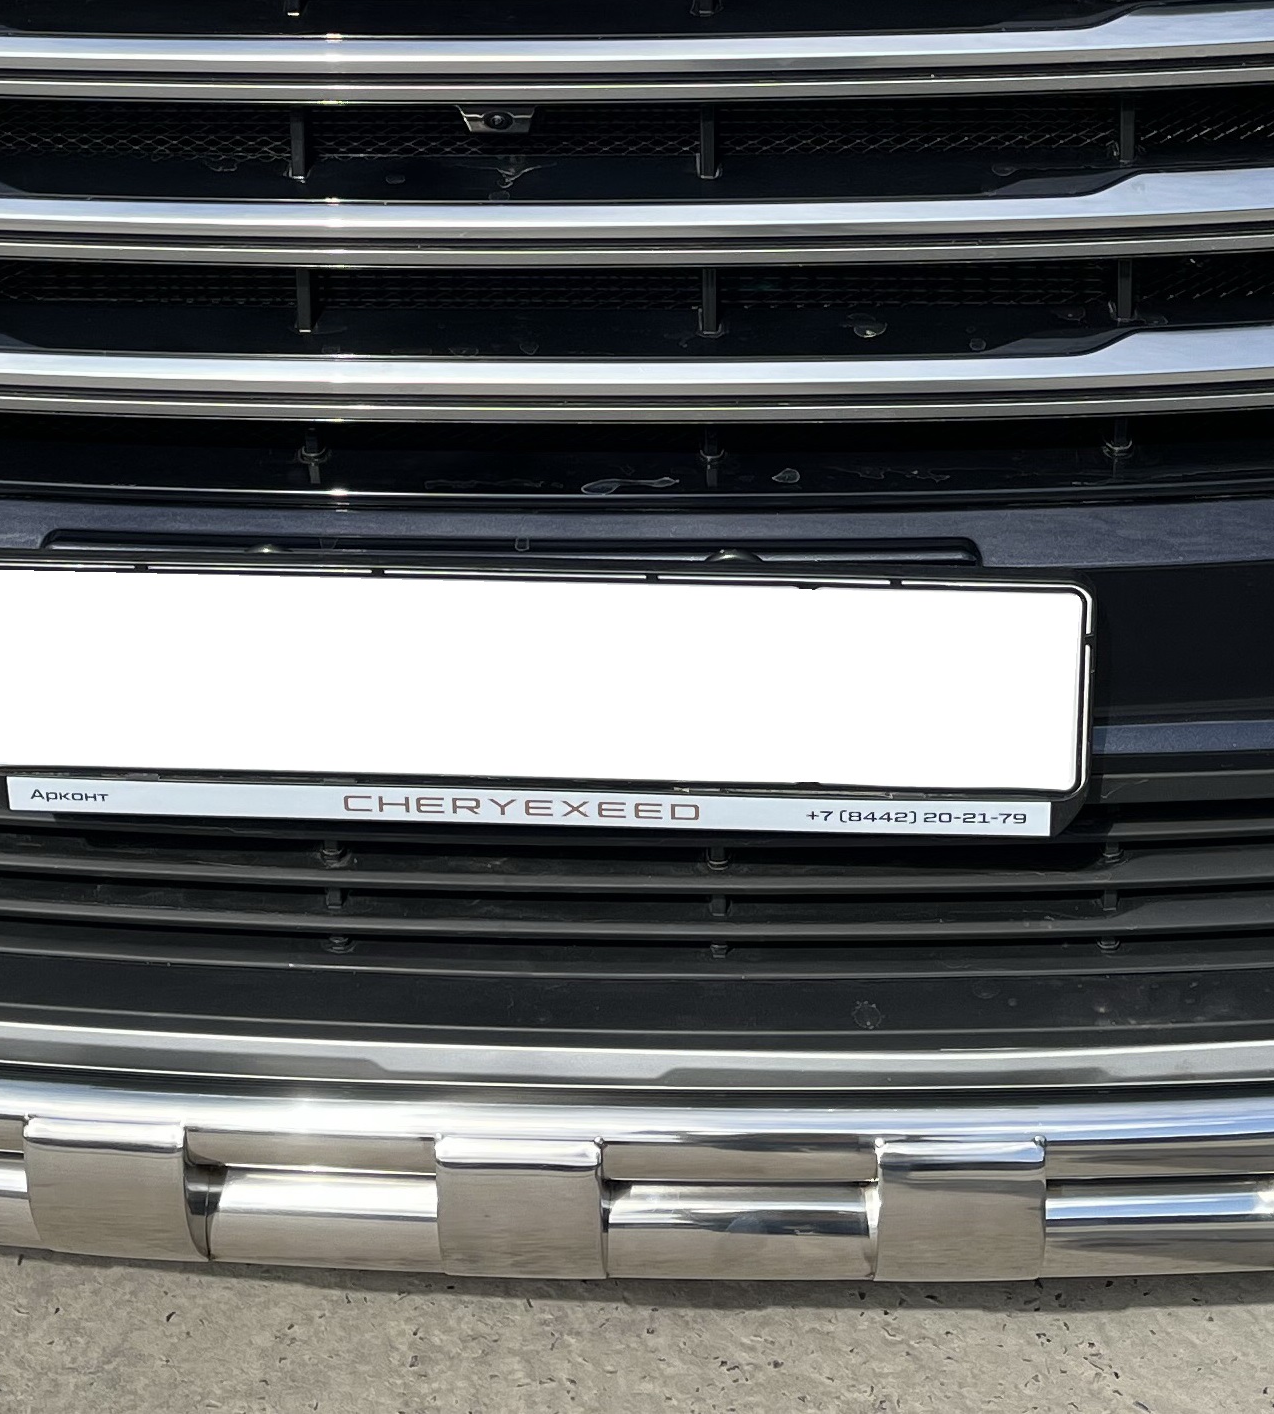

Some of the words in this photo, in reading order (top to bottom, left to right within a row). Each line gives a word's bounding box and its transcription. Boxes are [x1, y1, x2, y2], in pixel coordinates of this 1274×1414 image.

[30, 789, 108, 803] Арконт
[343, 794, 700, 821] CHERYEXEED
[805, 809, 834, 823] +7
[838, 809, 917, 824] (8442)
[922, 811, 1027, 824] 20-21-79
